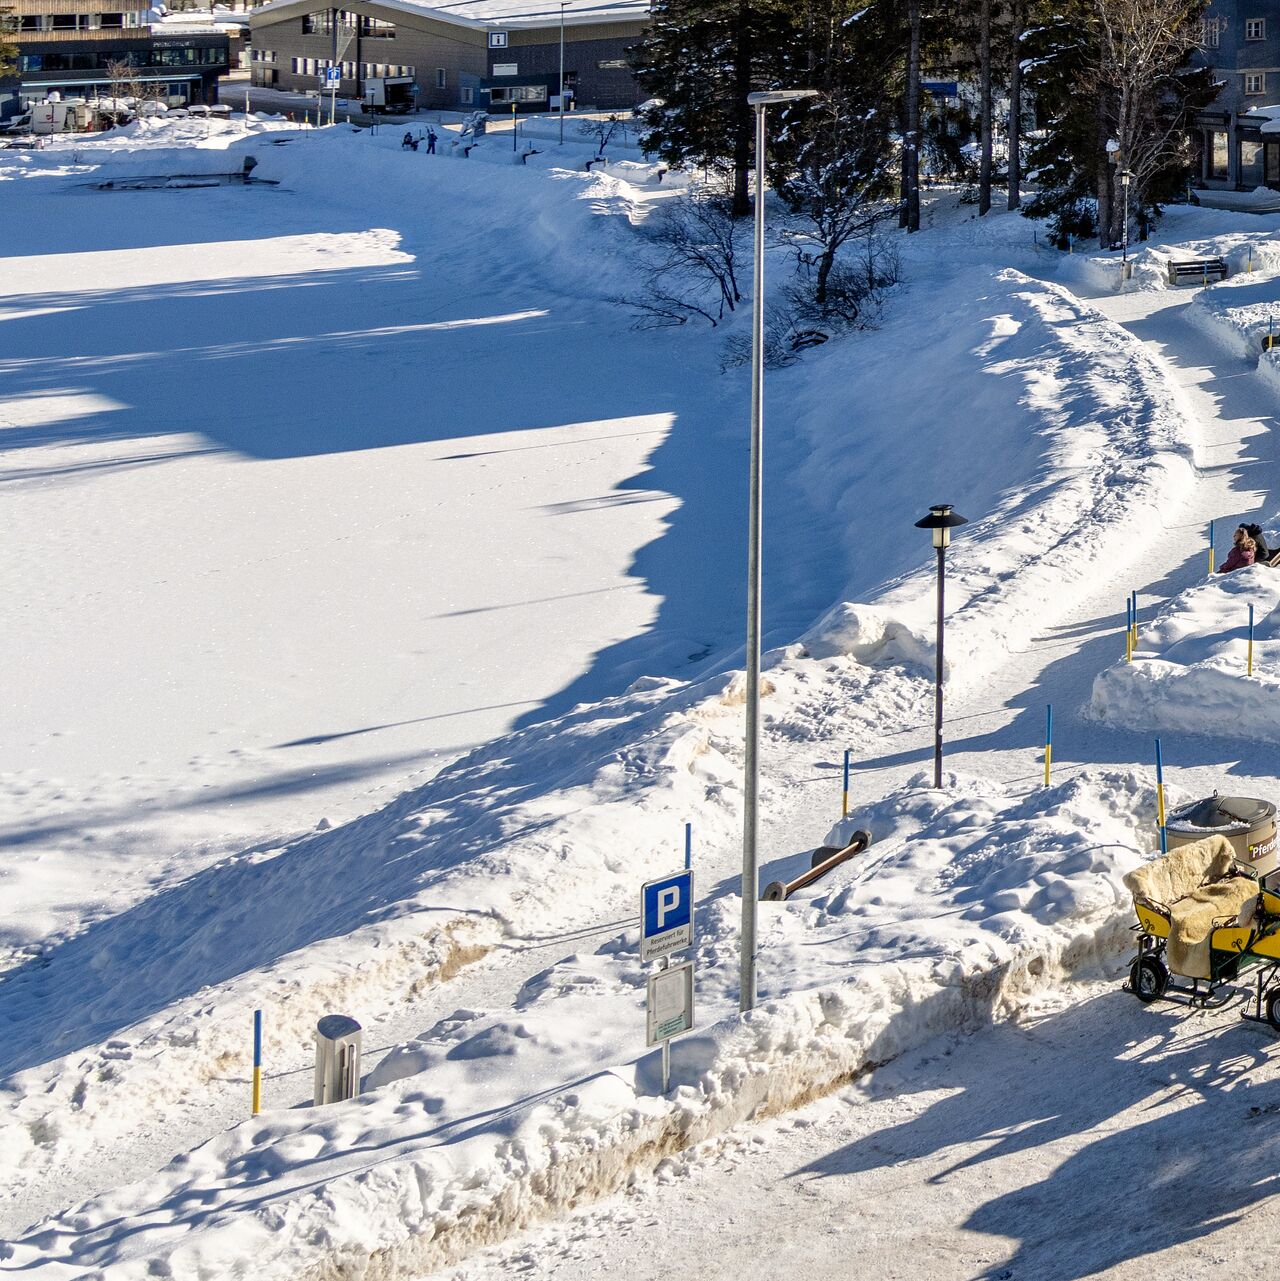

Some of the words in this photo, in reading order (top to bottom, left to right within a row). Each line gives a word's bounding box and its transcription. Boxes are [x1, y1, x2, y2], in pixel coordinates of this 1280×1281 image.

[657, 885, 680, 929] P
[646, 937, 688, 955] Pferdefuhrwerke
[650, 931, 676, 945] Reserviert
[676, 929, 684, 937] für
